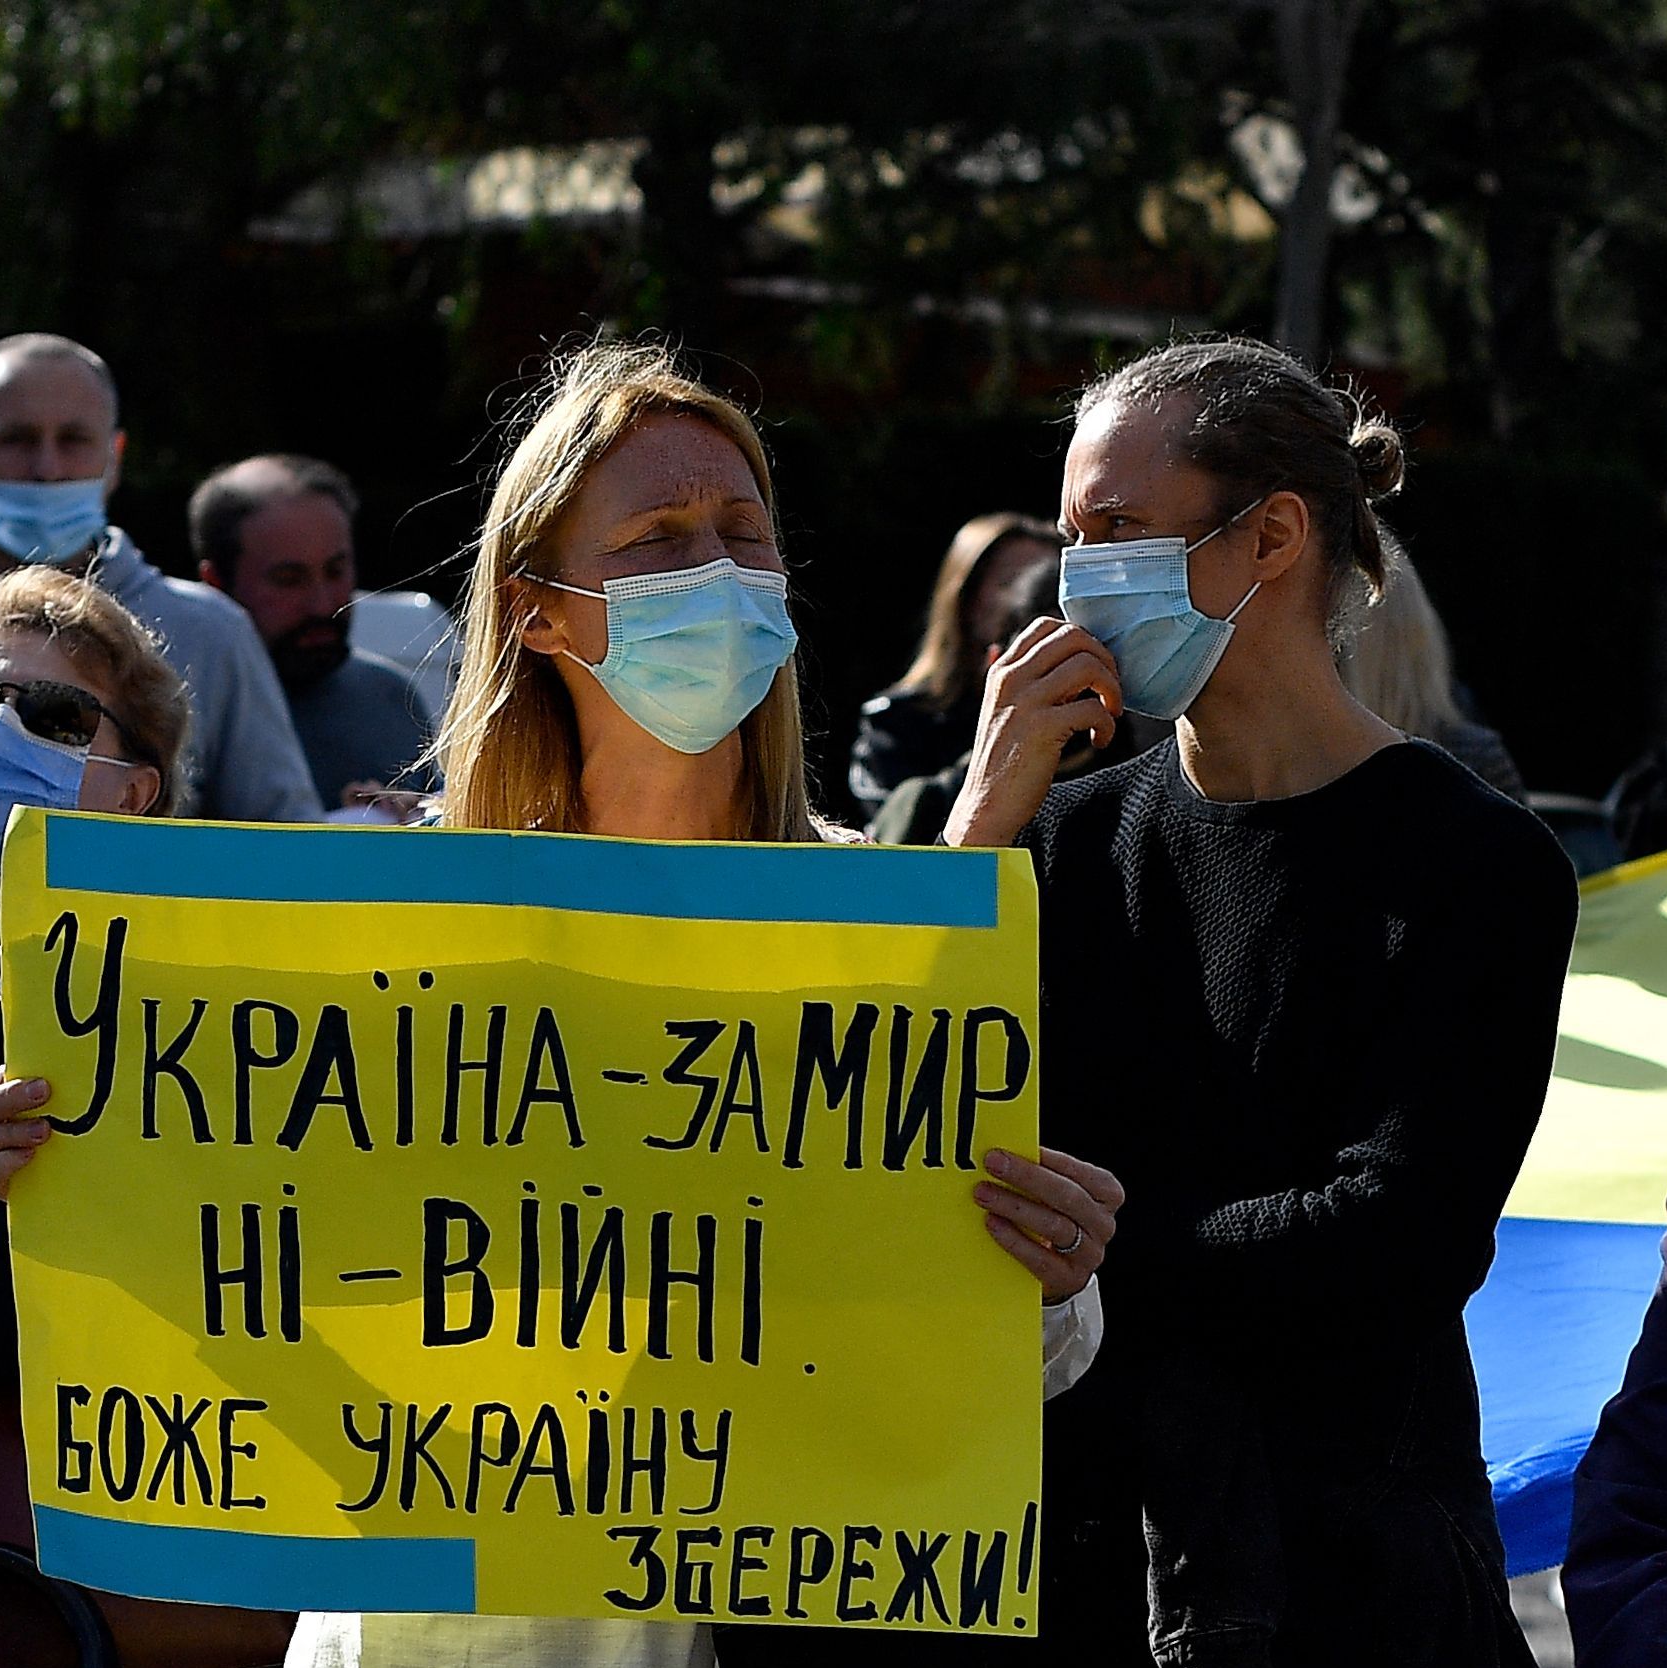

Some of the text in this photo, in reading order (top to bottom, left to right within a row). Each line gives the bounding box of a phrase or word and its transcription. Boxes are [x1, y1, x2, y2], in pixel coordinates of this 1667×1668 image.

[781, 1000, 1034, 1174] МИР
[56, 1384, 734, 1517] БОЖЕ УКРАЇНУ
[602, 1502, 1039, 1631] ЗБЕРЕЖИ!
